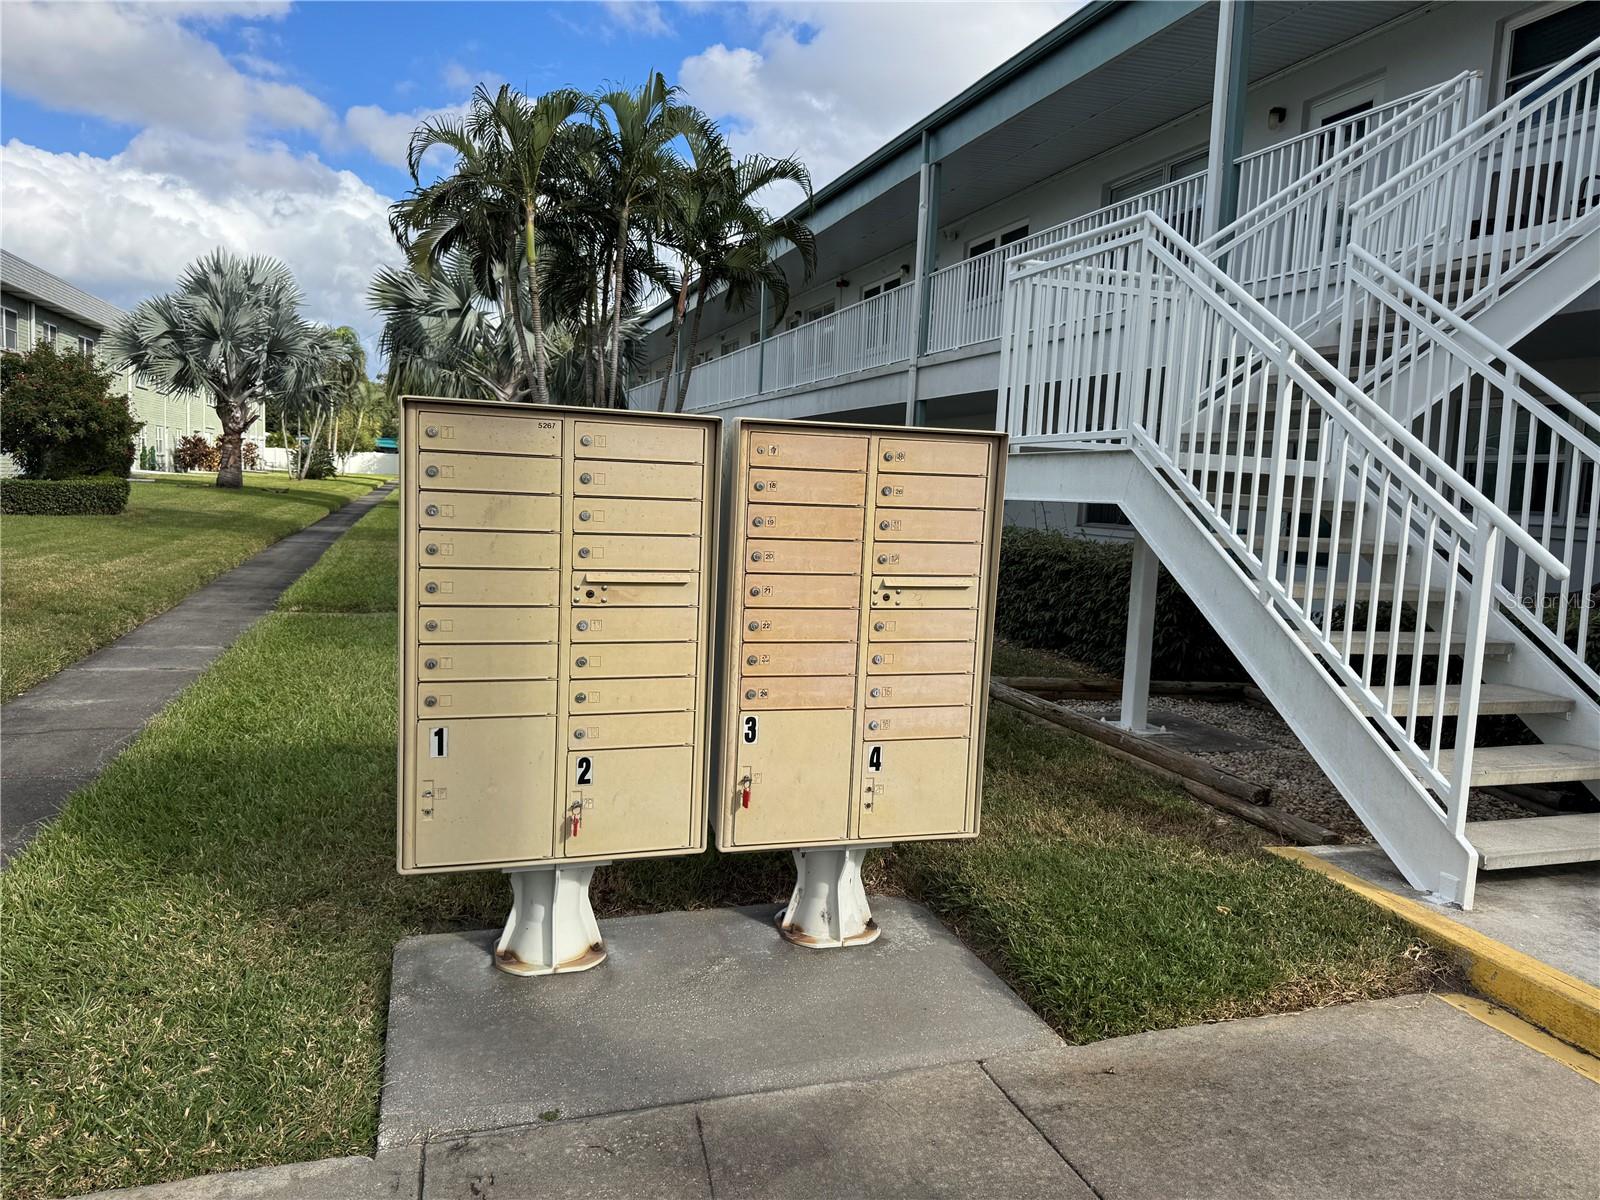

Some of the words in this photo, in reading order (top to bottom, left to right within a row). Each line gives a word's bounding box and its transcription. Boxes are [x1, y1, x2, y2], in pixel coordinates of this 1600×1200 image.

[434, 727, 444, 757] 1
[744, 716, 757, 744] 3
[577, 756, 591, 785] 2
[869, 746, 882, 771] 4
